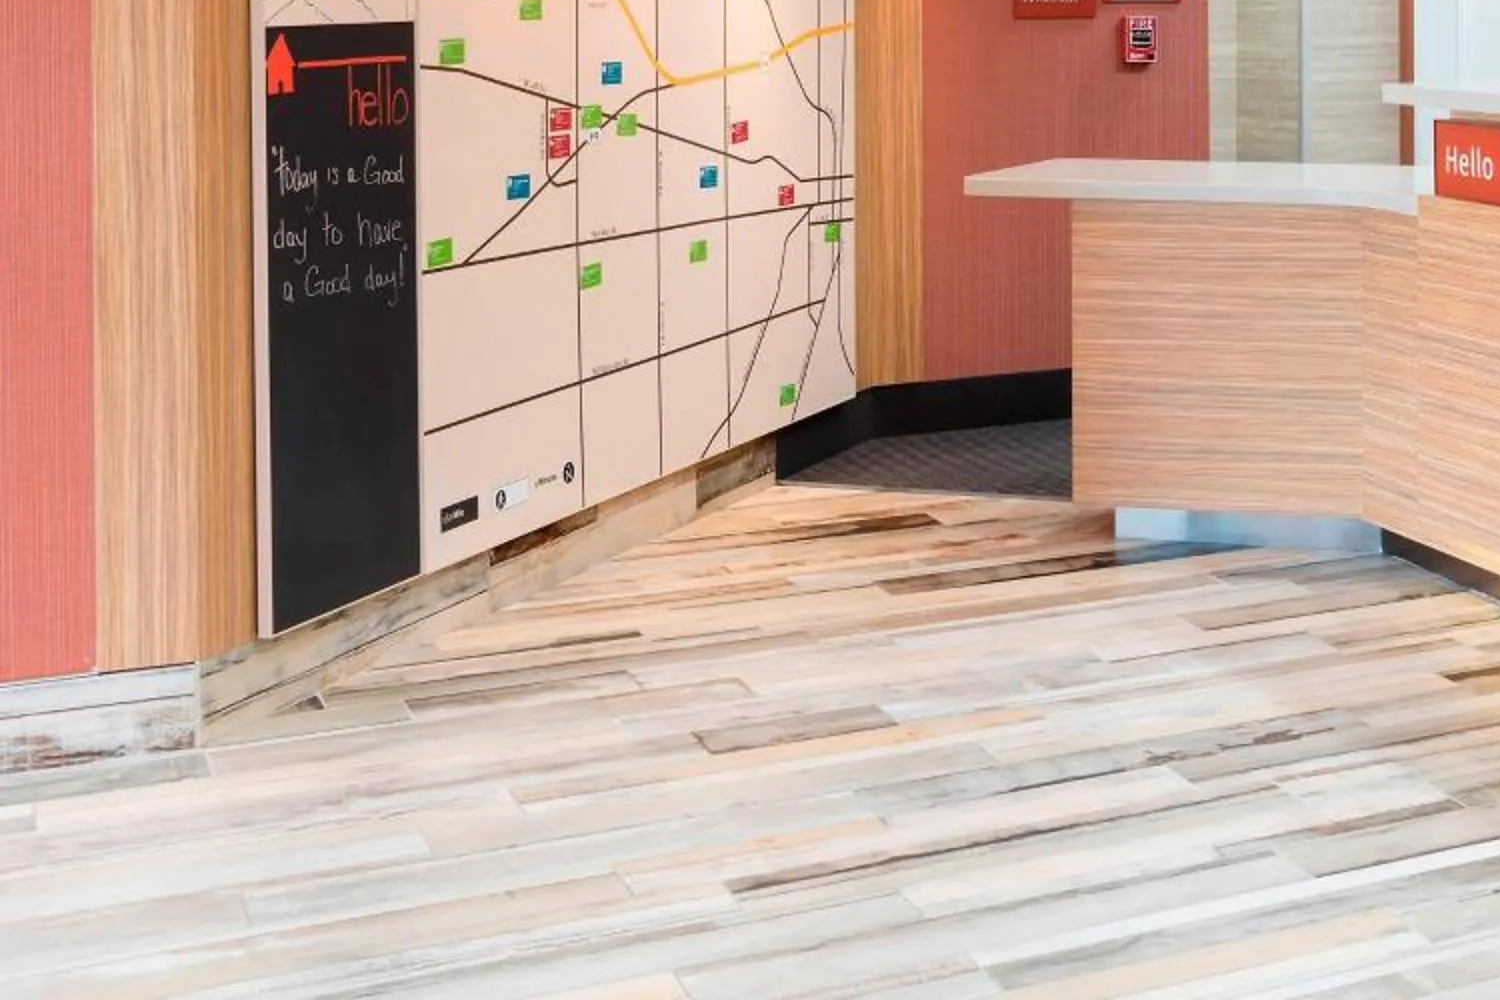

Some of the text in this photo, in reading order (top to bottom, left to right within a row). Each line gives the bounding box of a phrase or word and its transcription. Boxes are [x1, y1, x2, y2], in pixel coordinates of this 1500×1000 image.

[348, 63, 409, 127] hello
[364, 154, 404, 186] Good
[1445, 145, 1494, 181] Hello
[273, 210, 402, 264] day to have
[283, 280, 294, 303] a
[304, 263, 351, 297] Good
